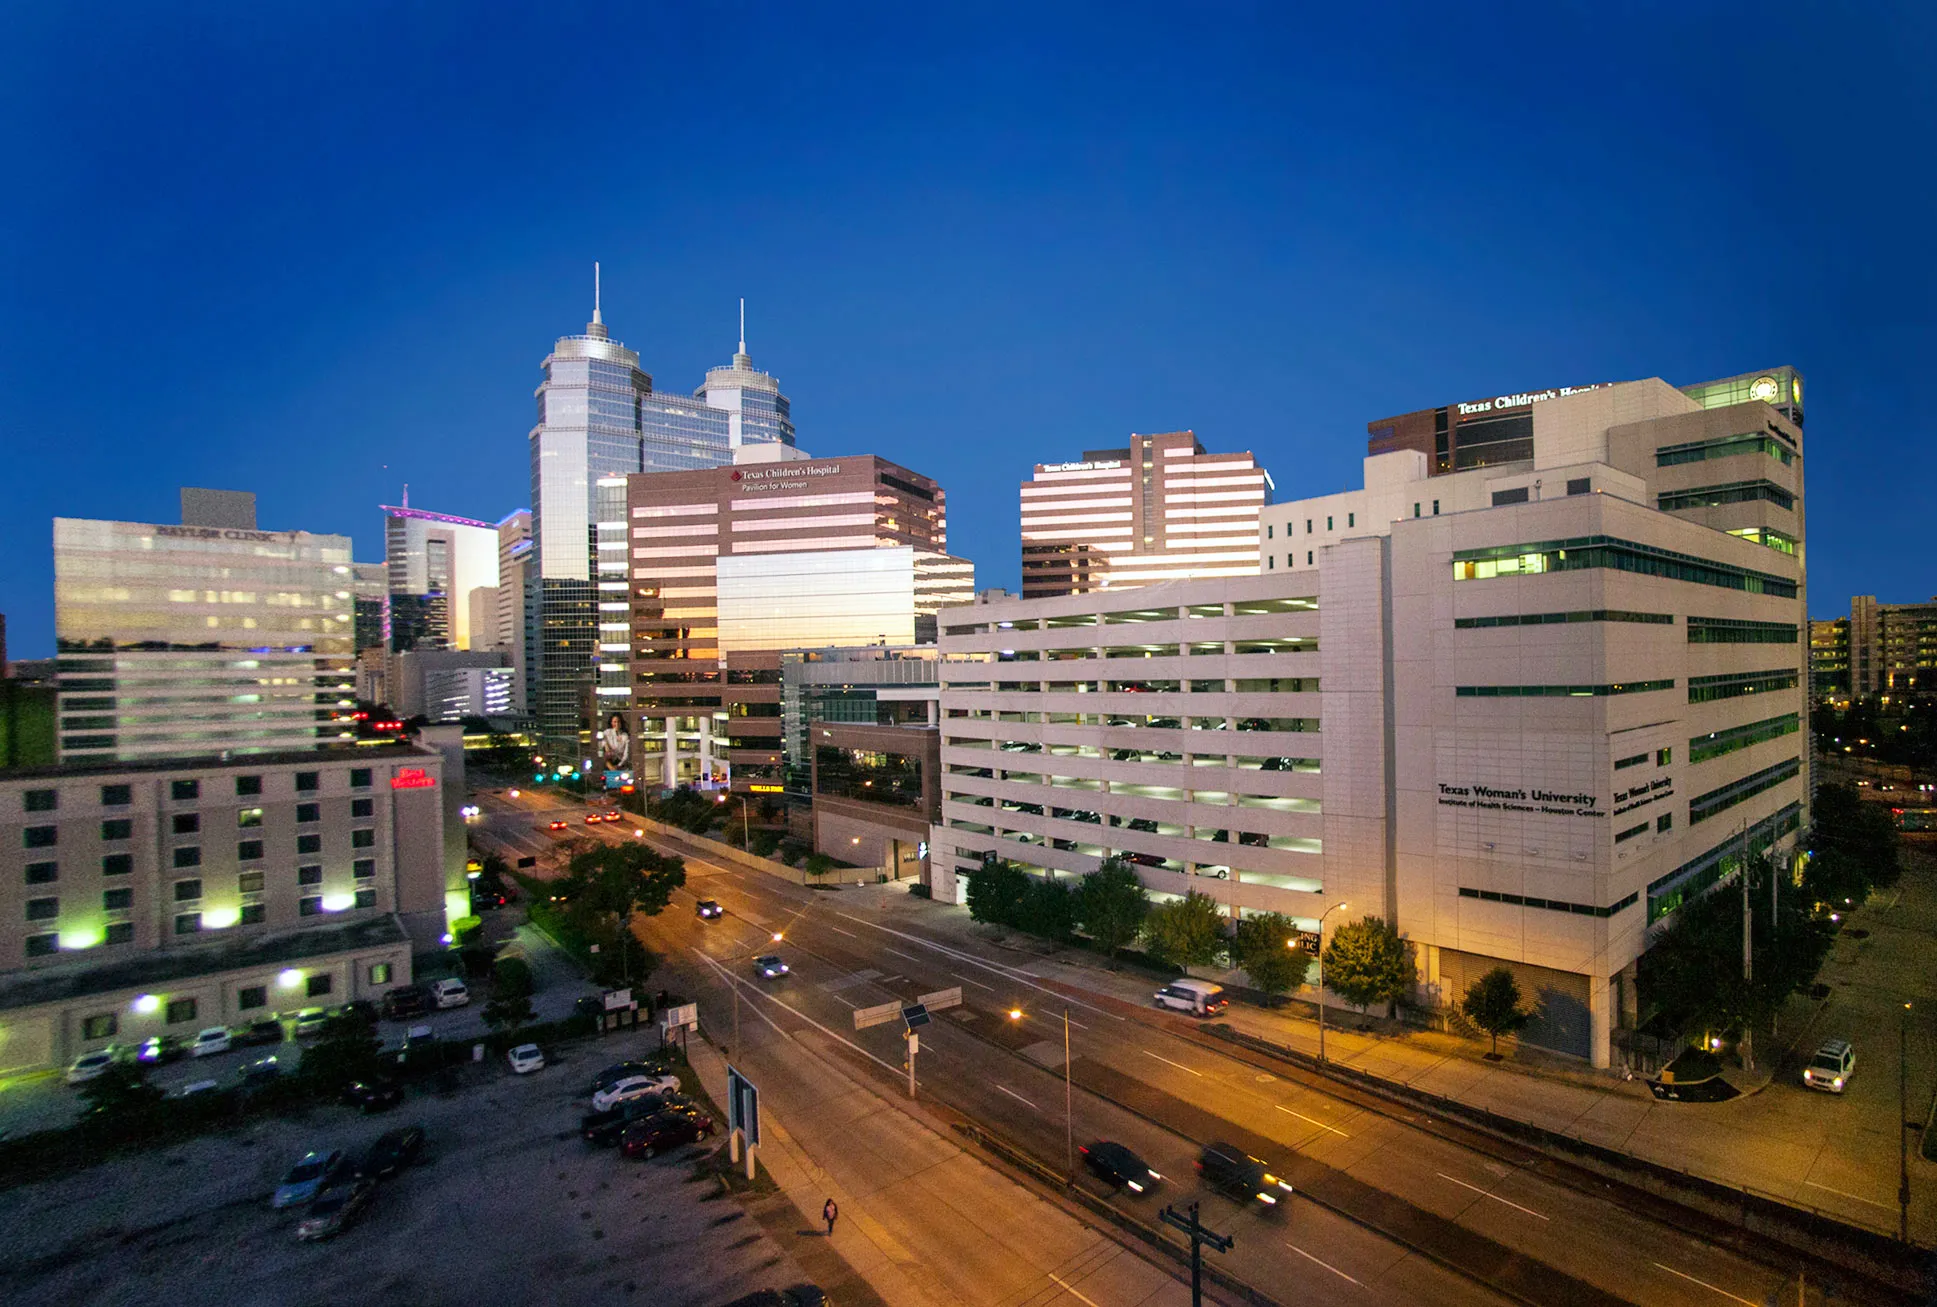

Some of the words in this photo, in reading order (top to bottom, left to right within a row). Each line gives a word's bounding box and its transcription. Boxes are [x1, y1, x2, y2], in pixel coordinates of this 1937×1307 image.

[1458, 402, 1491, 415] Texas
[1495, 390, 1556, 408] Children's
[742, 470, 764, 480] Texas
[765, 466, 806, 478] Children's
[806, 464, 840, 477] Hospital
[742, 483, 768, 492] Pavilion
[769, 482, 780, 490] for
[780, 481, 808, 489] Women
[1439, 784, 1469, 796] Texas
[1473, 786, 1526, 800] Woman's
[1531, 789, 1597, 808] University
[1613, 793, 1627, 803] Texas
[1438, 798, 1468, 807] Institute
[1468, 799, 1477, 808] of
[1477, 801, 1500, 810] Health
[1502, 802, 1534, 813] Sciences
[1541, 805, 1575, 816] Houston
[1576, 808, 1606, 818] Center
